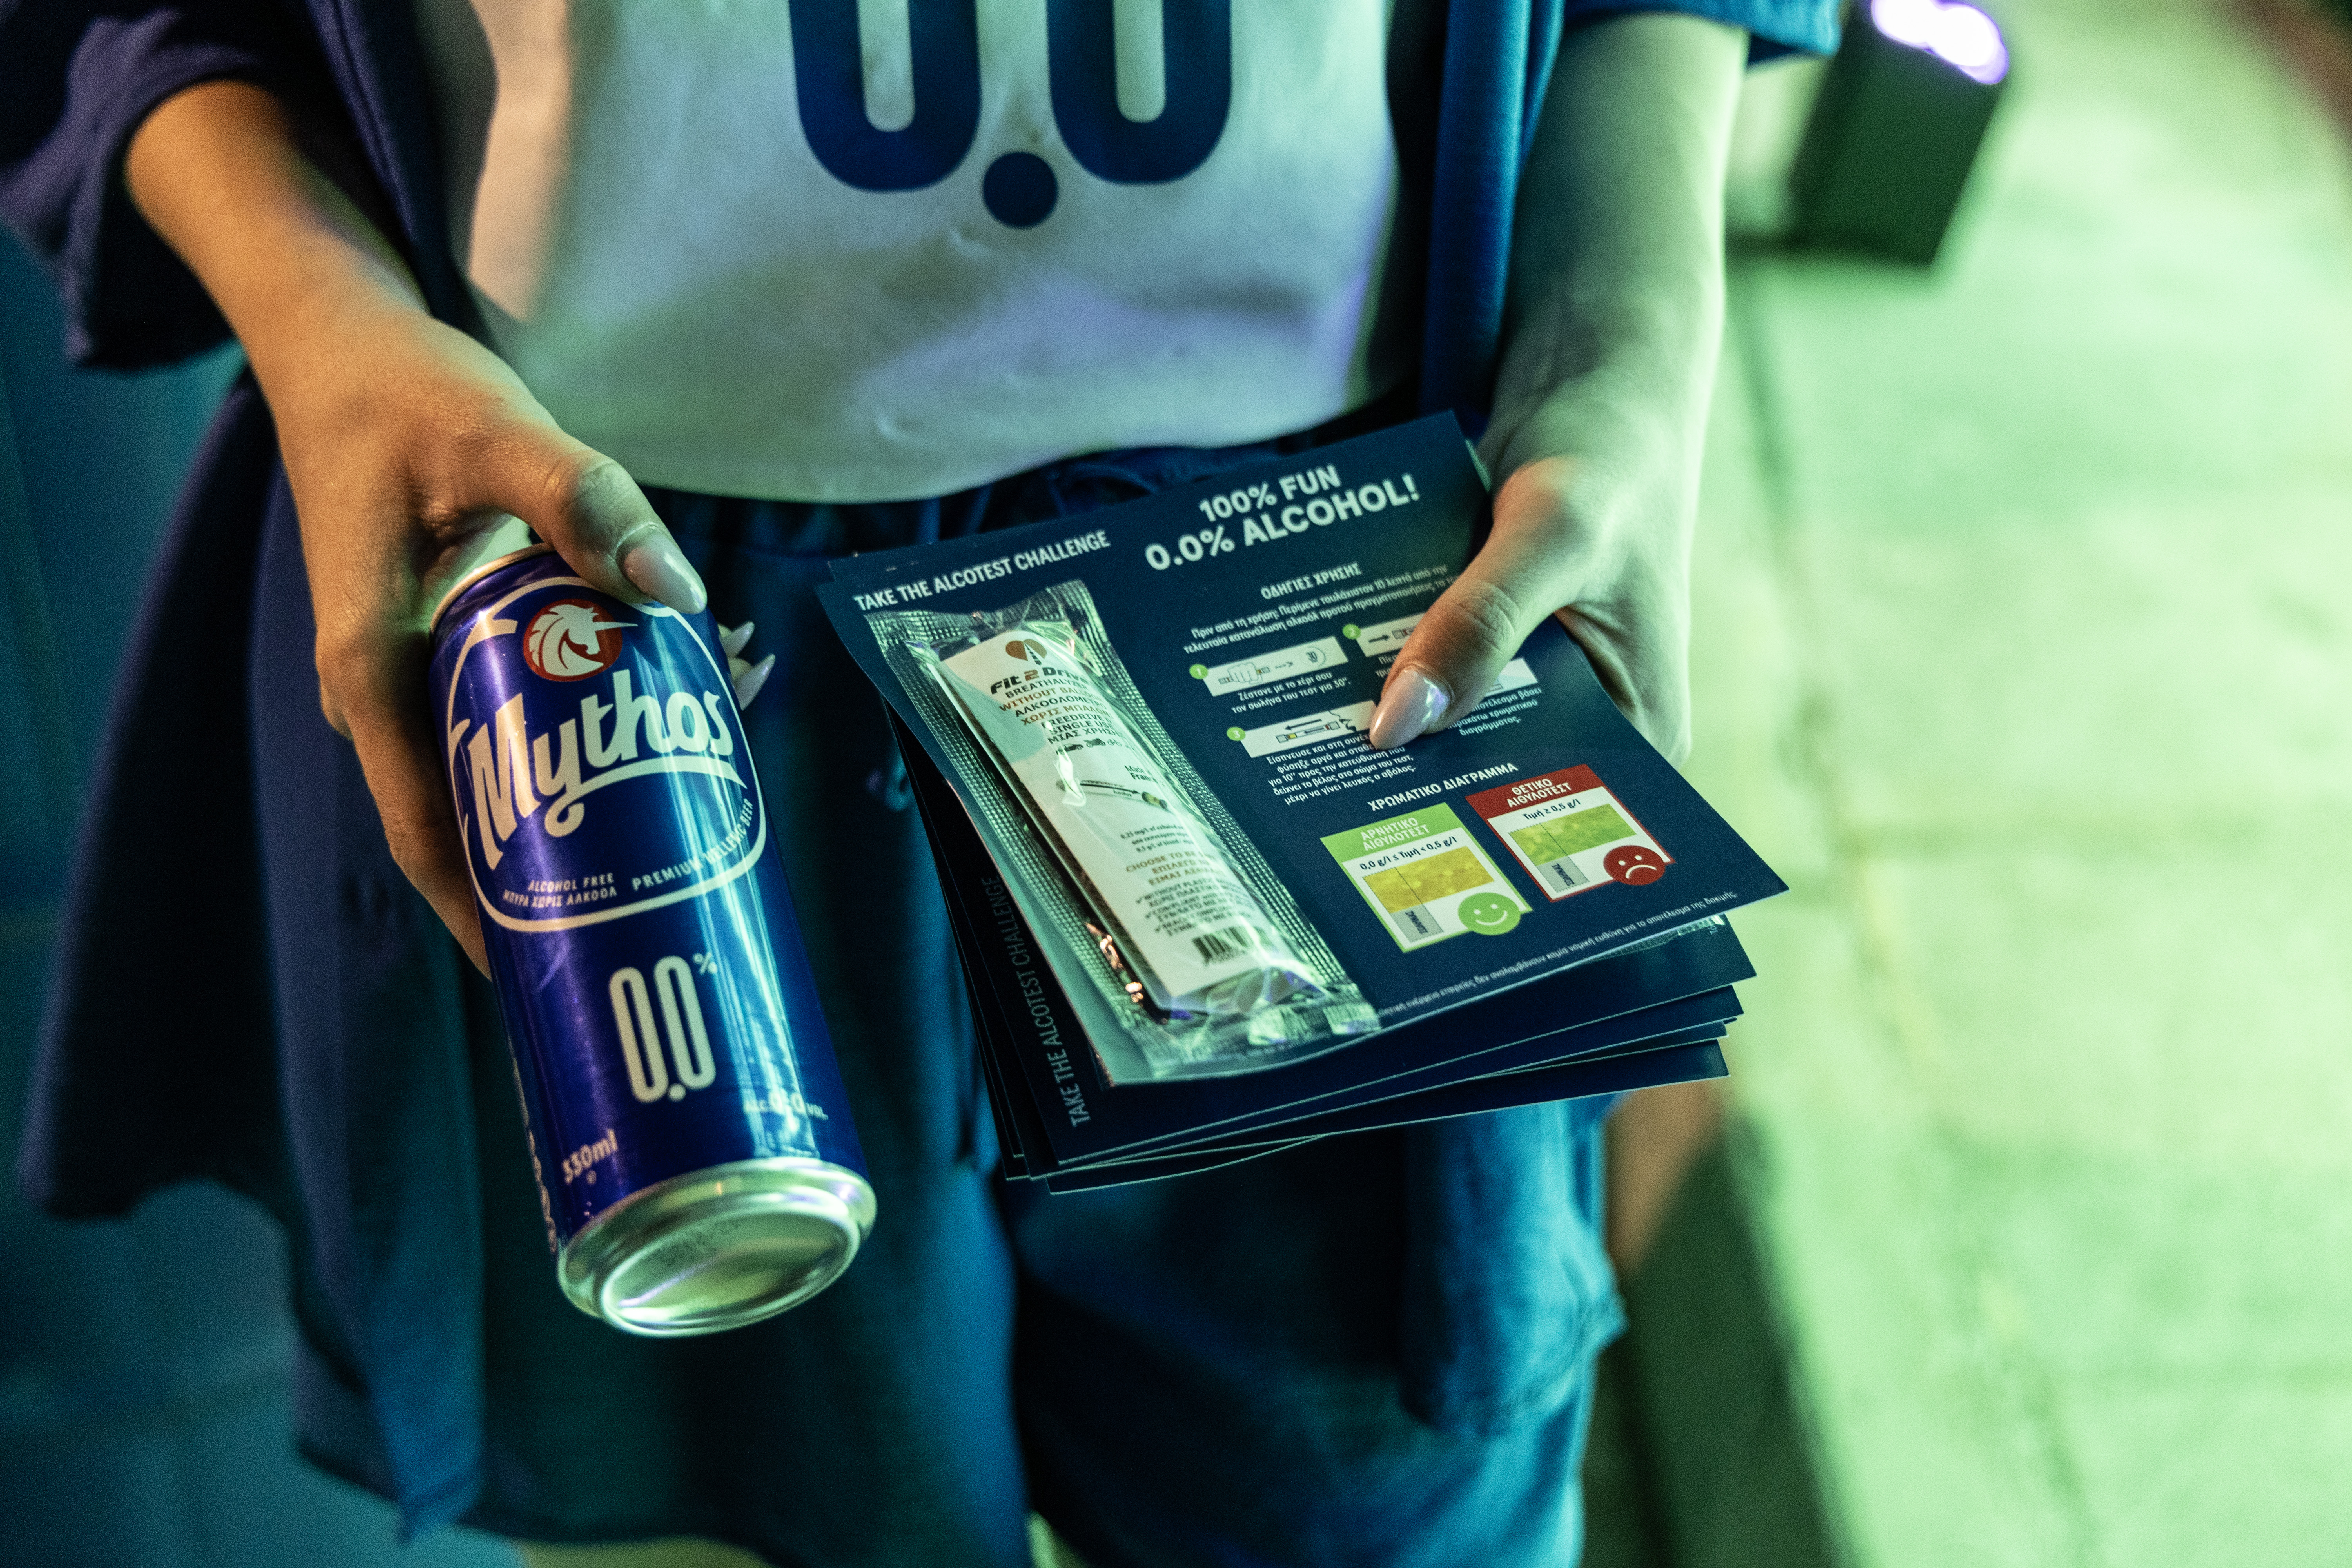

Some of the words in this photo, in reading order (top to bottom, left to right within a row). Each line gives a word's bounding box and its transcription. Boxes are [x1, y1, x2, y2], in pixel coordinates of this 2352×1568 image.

[1199, 483, 1277, 522] 100%
[1279, 465, 1341, 500] FUN
[1145, 525, 1235, 570] 0.0%
[1243, 474, 1419, 546] ALCOHOL!
[854, 588, 898, 611] TAKE
[896, 581, 933, 601] THE
[934, 558, 1012, 593] ALCOTEST
[1014, 530, 1111, 570] CHALLENGE
[1261, 576, 1314, 599] ΟΔΗΓΙΕΣ
[1313, 563, 1362, 586] ΧΡΗΣΗΣ
[1191, 627, 1214, 639] Πριν
[1214, 620, 1234, 633] από
[1234, 618, 1248, 628] τη
[1278, 599, 1320, 615] Περίμενε
[1319, 584, 1374, 604] τουλάχιστον
[1374, 579, 1386, 590] 10
[1385, 573, 1413, 587] λεπτά
[1412, 568, 1431, 580] από
[1183, 635, 1229, 654] τελευταία
[1228, 621, 1287, 642] κατανάλωση
[1286, 611, 1319, 627] αλκοόλ
[1319, 602, 1353, 619] προτού
[990, 675, 1022, 695] Fit
[1024, 669, 1039, 681] 2
[1005, 678, 1087, 699] BREATHALYZER
[1238, 687, 1273, 701] Ζέστανε
[1273, 684, 1285, 694] με
[1296, 677, 1314, 686] χέρι
[1315, 672, 1332, 681] σου
[1517, 687, 1542, 700] βάσει
[998, 688, 1056, 712] WITHOUT
[1231, 705, 1247, 713] τον
[1248, 696, 1282, 710] σωλήνα
[1282, 692, 1298, 701] του
[1299, 687, 1318, 697] τεστ
[1318, 683, 1333, 693] για
[1489, 699, 1538, 718] χρωματικού
[1020, 708, 1061, 726] ΧΩΡΙΣ
[1049, 720, 1093, 735] SINGLE
[1459, 713, 1521, 736] διαγράμματος.
[1047, 730, 1080, 744] ΜΙΑΣ
[1266, 749, 1312, 764] Είσπνευσε
[1327, 740, 1345, 750] στη
[1344, 734, 1372, 745] συνέχ
[467, 668, 747, 871] Mythos
[1268, 778, 1283, 788] για
[1298, 768, 1322, 779] προς
[1321, 764, 1336, 772] την
[1337, 751, 1389, 768] κατεύθυνση
[1388, 747, 1405, 755] που
[1277, 759, 1310, 775] φύσηξε
[1310, 753, 1333, 765] αργά
[1348, 744, 1372, 755] σταθε
[1272, 784, 1302, 795] δείχνει
[1312, 775, 1339, 787] βέλος
[1337, 771, 1353, 779] στο
[1353, 764, 1377, 775] σώμα
[1377, 760, 1393, 768] του
[1393, 755, 1414, 764] τεστ,
[1284, 793, 1308, 806] μέχρι
[1321, 784, 1342, 795] γίνει
[1341, 776, 1374, 789] λευκός
[1381, 765, 1416, 778] σβόλος.
[1367, 783, 1442, 811] ΧΡΩΜΑΤΙΚΟ
[1443, 762, 1519, 790] ΔΙΑΓΡΑΜΜΑ
[1512, 778, 1553, 795] ΘΕΤΙΚΟ
[1507, 782, 1572, 808] ΑΙΘΥΛΟΤΕΣΤ
[1522, 810, 1545, 820] Τιμή
[1550, 803, 1566, 812] 0,5
[1361, 817, 1418, 841] ΑΡΝΗΤΙΚΟ
[1363, 824, 1430, 851] ΑΙΘΥΛΟΤΕΣΤ
[632, 856, 701, 891] PREMIUM
[735, 799, 753, 839] BEER
[1359, 860, 1376, 870] 0,0
[1398, 848, 1421, 858] Τιμή
[1426, 841, 1442, 850] 0,5
[503, 888, 530, 908] ΜΠΥΡΑ
[532, 893, 562, 909] ΧΩΡΙΣ
[564, 886, 617, 906] ΑΛΚΟΟΛ
[528, 877, 577, 895] ALCOHOL
[583, 873, 614, 888] FREE
[982, 877, 1030, 966] CHALLENGE
[1568, 938, 1596, 951] νομική
[1594, 928, 1625, 942] ευθύνη
[1622, 924, 1637, 933] για
[1646, 906, 1691, 924] αποτέλεσμα
[1016, 971, 1063, 1045] ALCOTEST
[609, 953, 718, 1103] 0.0%
[1047, 1049, 1074, 1083] THE
[1060, 1083, 1091, 1127] TAKE
